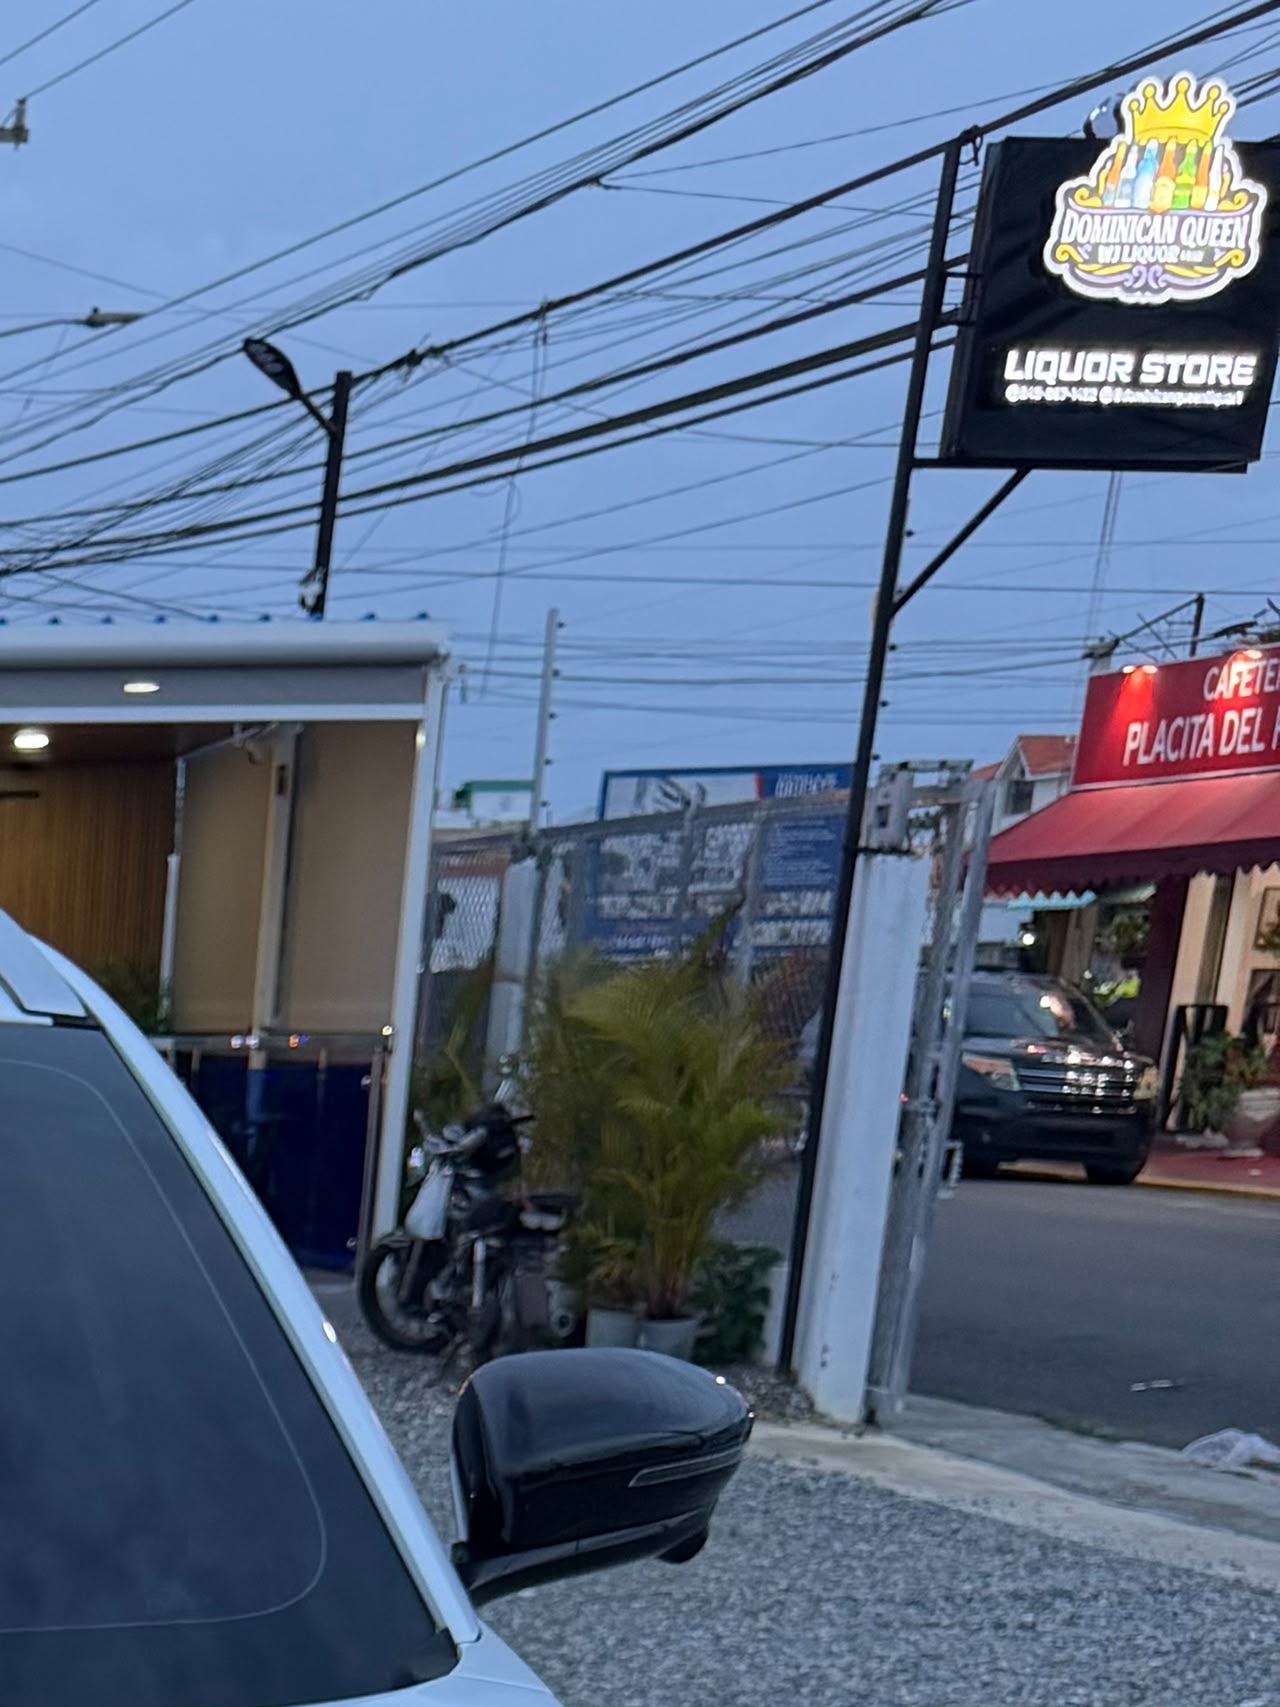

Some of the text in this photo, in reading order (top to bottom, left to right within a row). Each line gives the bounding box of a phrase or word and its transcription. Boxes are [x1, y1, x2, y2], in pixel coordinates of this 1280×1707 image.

[1061, 210, 1250, 249] DOMINICAN QUEEN
[1122, 245, 1180, 264] LIQUOR
[1003, 349, 1257, 386] LIQUOR STORE
[1203, 656, 1280, 701] CAFETE
[1122, 712, 1216, 767] PLACITA
[1218, 706, 1265, 757] DEL
